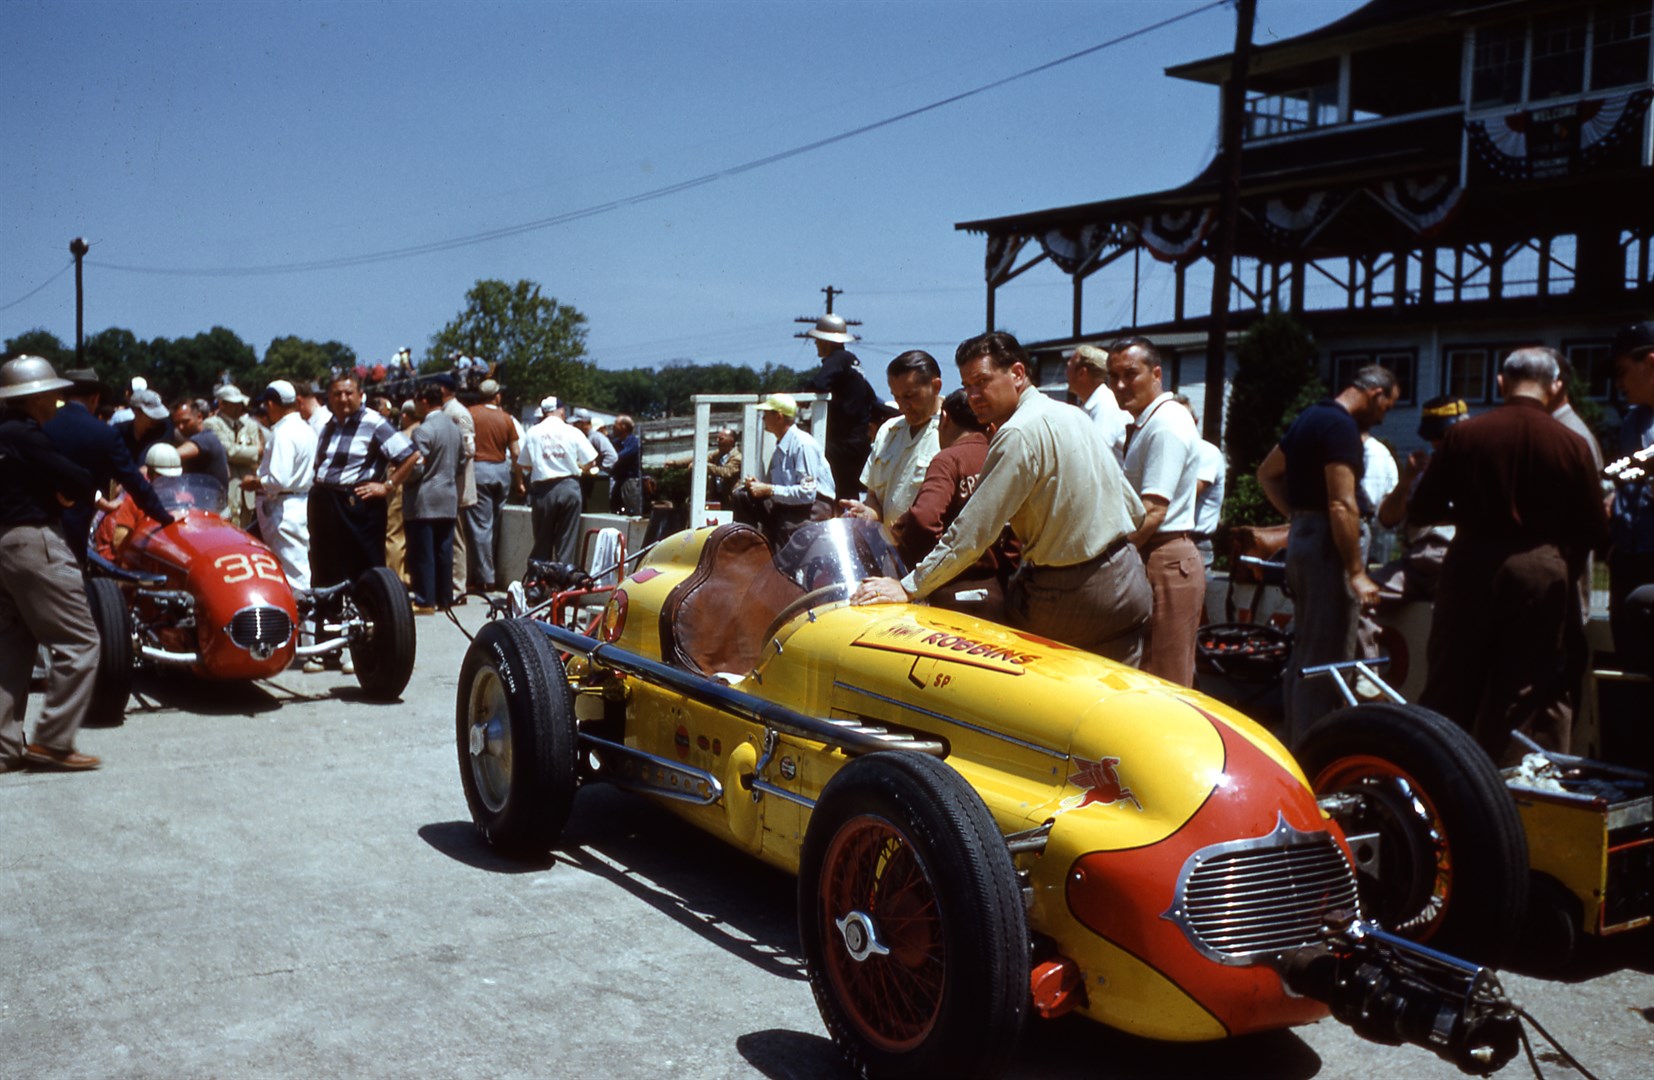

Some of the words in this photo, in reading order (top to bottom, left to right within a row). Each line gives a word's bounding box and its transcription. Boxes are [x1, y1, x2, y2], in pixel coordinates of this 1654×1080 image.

[1532, 104, 1577, 122] WELCOME
[959, 473, 980, 498] SP
[213, 553, 284, 584] 32
[921, 632, 1042, 665] ROBBINS
